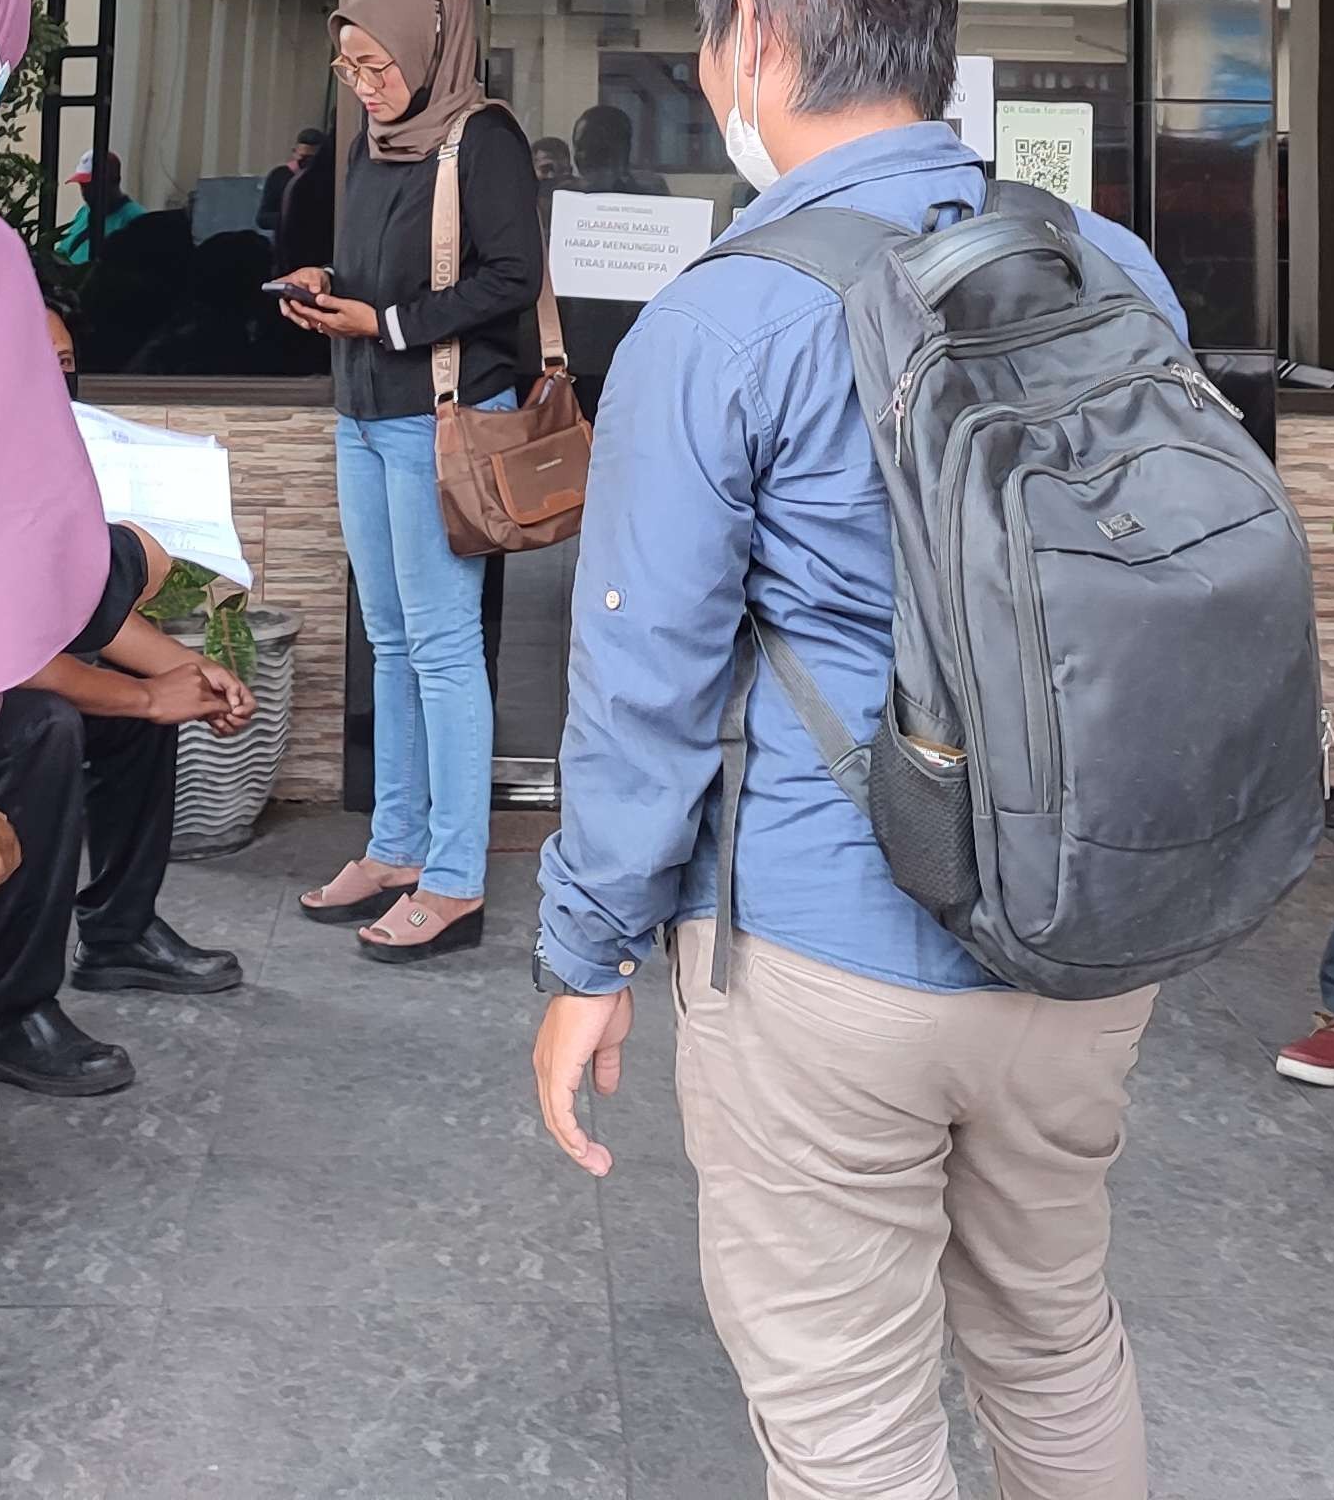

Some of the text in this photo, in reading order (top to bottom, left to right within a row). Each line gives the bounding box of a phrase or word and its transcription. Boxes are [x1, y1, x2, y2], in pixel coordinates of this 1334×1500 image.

[576, 219, 670, 235] DILARANG MASUK
[564, 238, 679, 255] HARAP MENUNGGU DI
[573, 257, 668, 273] TERAS RUANG PPA
